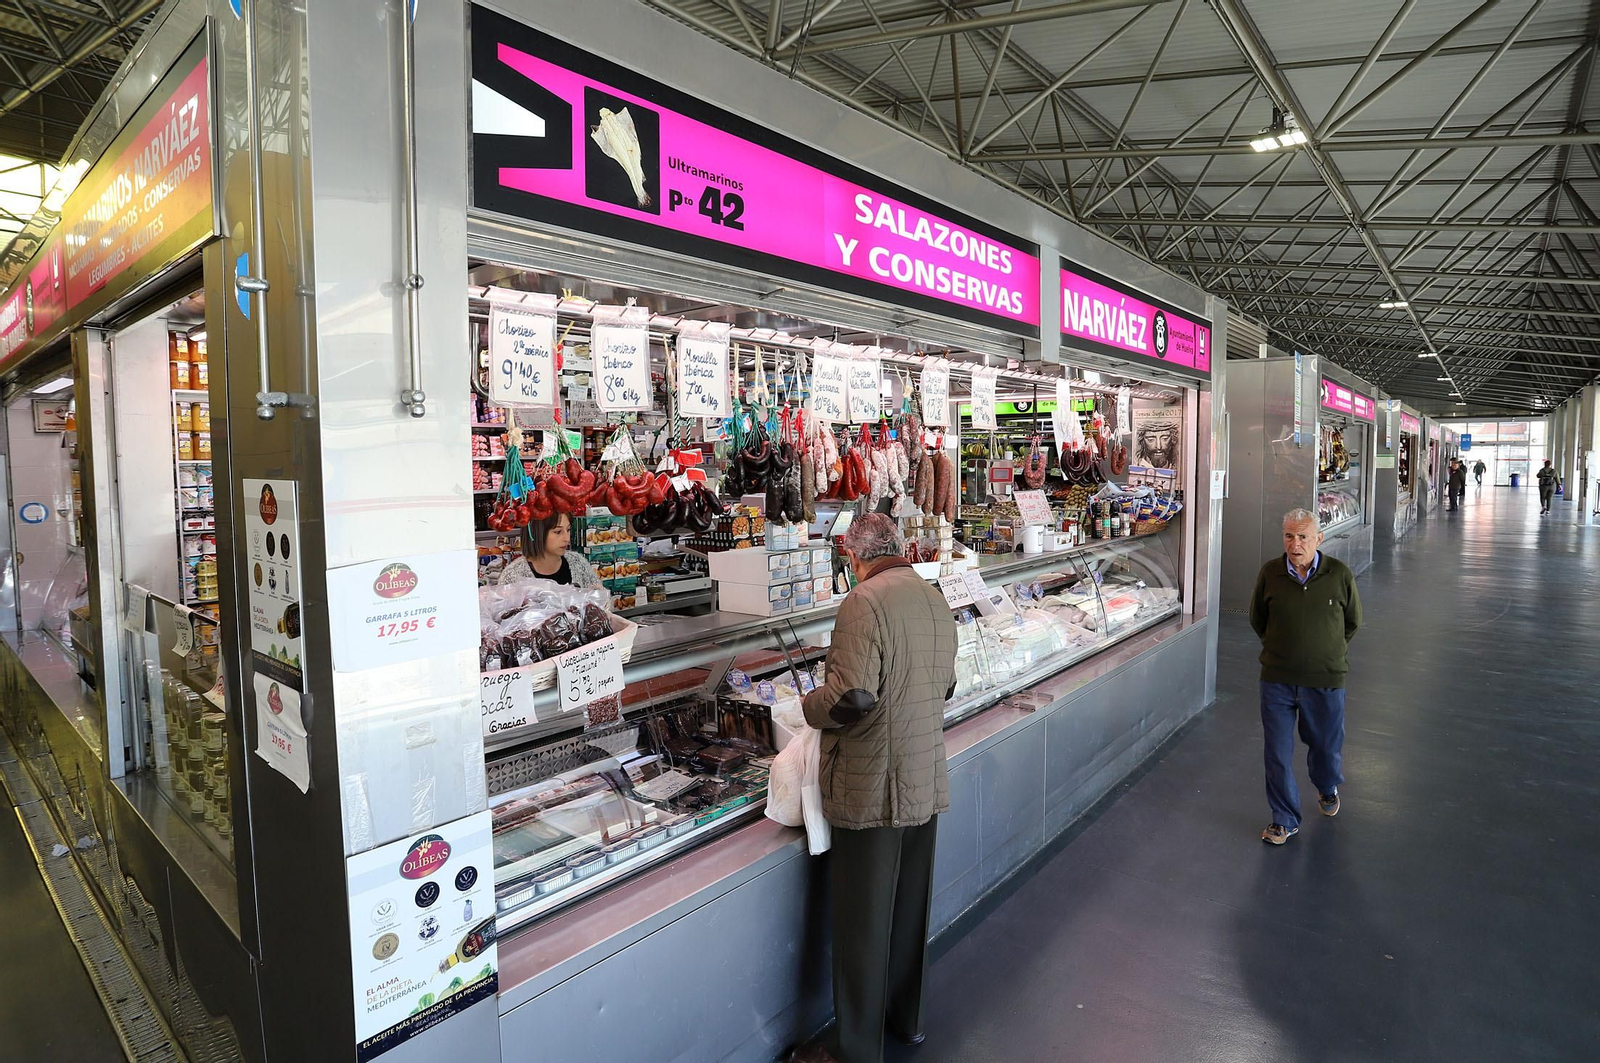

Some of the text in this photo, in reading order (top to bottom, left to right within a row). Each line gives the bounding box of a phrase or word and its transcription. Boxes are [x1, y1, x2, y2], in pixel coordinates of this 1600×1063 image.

[133, 94, 200, 195] NARVÁEZ
[143, 147, 201, 213] CONSERVAS
[668, 156, 744, 191] Ultramarinos
[699, 186, 744, 231] 42
[854, 193, 1013, 274] SALAZONES
[89, 245, 126, 287] LEGUMBRES
[131, 214, 164, 255] ACEITES
[833, 232, 1023, 315] Y CONSERVAS
[498, 318, 537, 337] Chorizo
[1063, 288, 1147, 350] NARVÁEZ
[1176, 342, 1194, 355] de Huelva
[684, 364, 715, 378] Ibérica
[1166, 409, 1182, 417] 2017
[260, 502, 277, 514] OLIBEAS
[375, 577, 416, 592] OLIBEAS
[365, 612, 402, 624] GARRAFA
[410, 606, 437, 617] LITROS
[377, 616, 436, 638] 17,95 €
[481, 696, 514, 716] ocar
[489, 716, 527, 734] Gracias
[402, 848, 449, 873] OLIBEAS
[366, 976, 400, 997] EL ALMA
[366, 978, 413, 1005] DE LA DIETA
[367, 980, 428, 1014] MEDITERRÁNEA
[363, 976, 494, 1049] EL ACEITE MÁS PREMIADO DE LA PROVINCIA
